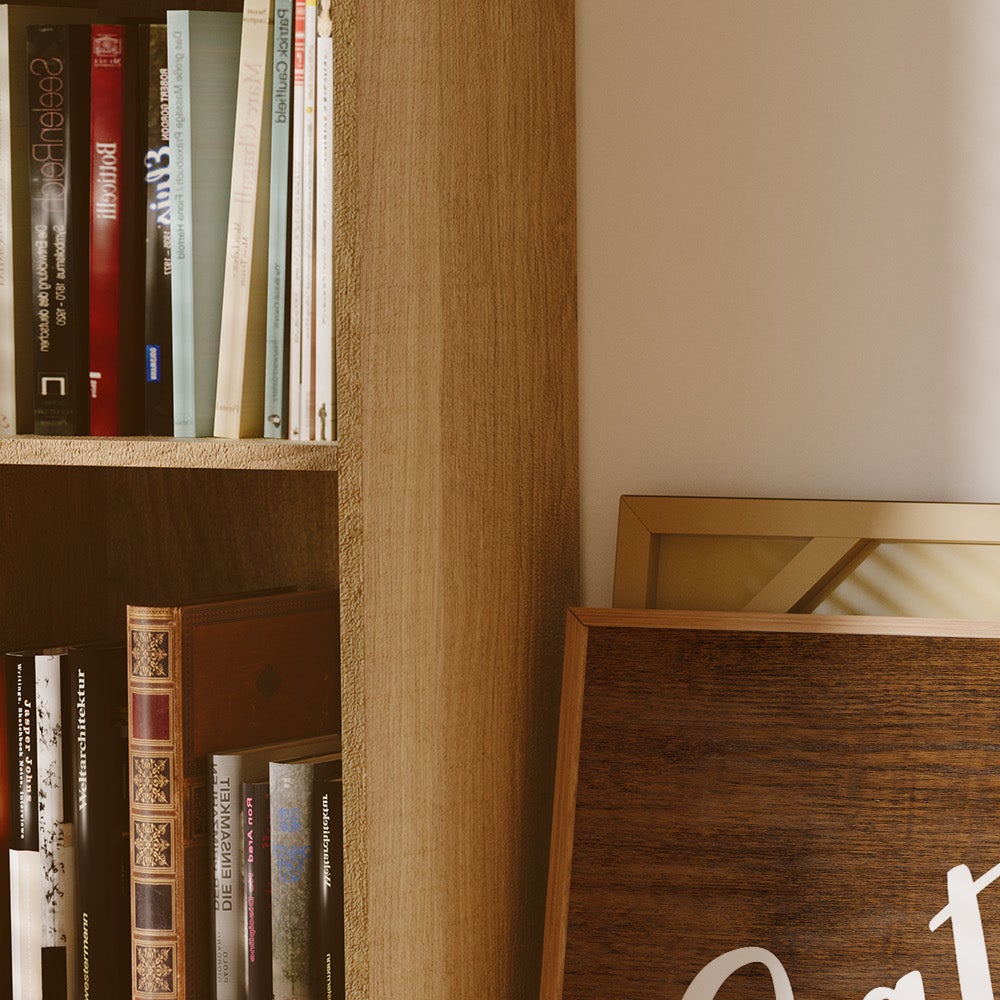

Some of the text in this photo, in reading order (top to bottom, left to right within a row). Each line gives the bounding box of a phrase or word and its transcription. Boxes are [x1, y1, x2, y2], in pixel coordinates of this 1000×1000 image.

[23, 700, 34, 802] Jasper Johns
[77, 669, 88, 811] Weltarchitektur
